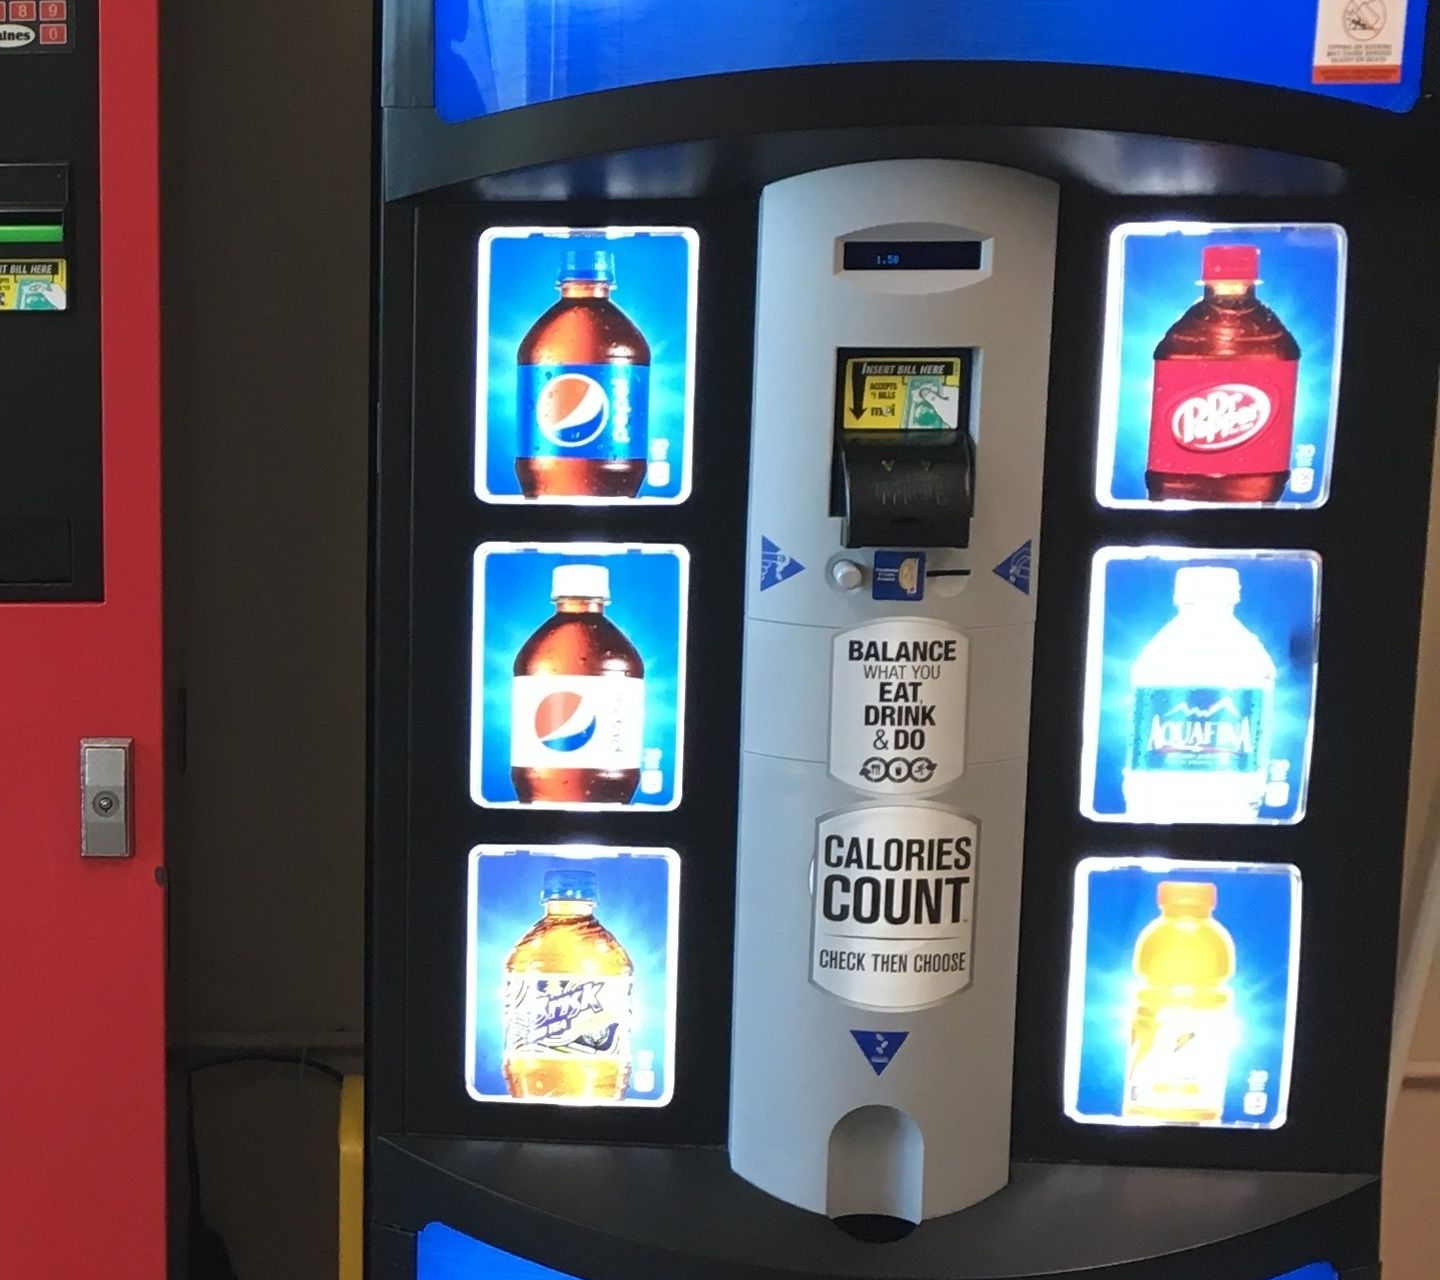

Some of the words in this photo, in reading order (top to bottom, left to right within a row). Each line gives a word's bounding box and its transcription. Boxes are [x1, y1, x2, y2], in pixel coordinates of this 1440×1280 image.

[18, 4, 27, 17] 8
[49, 4, 57, 17] 9
[10, 263, 27, 274] BILL
[30, 263, 53, 274] HERE
[877, 254, 899, 265] 1.50
[861, 362, 895, 375] INSERT
[897, 364, 917, 374] BILL
[920, 364, 946, 374] HERE
[848, 640, 957, 662] BALANCE
[863, 664, 907, 680] WHAT
[911, 664, 941, 680] YOU
[864, 705, 936, 726] DRINK
[873, 729, 889, 751] &
[894, 729, 926, 750] DO
[1147, 715, 1254, 752] AQUAFINA
[824, 834, 972, 872] CALORIES
[822, 873, 970, 925] COUNT
[819, 949, 866, 971] CHECK
[872, 953, 908, 973] THEN
[914, 952, 967, 973] CHOOSE
